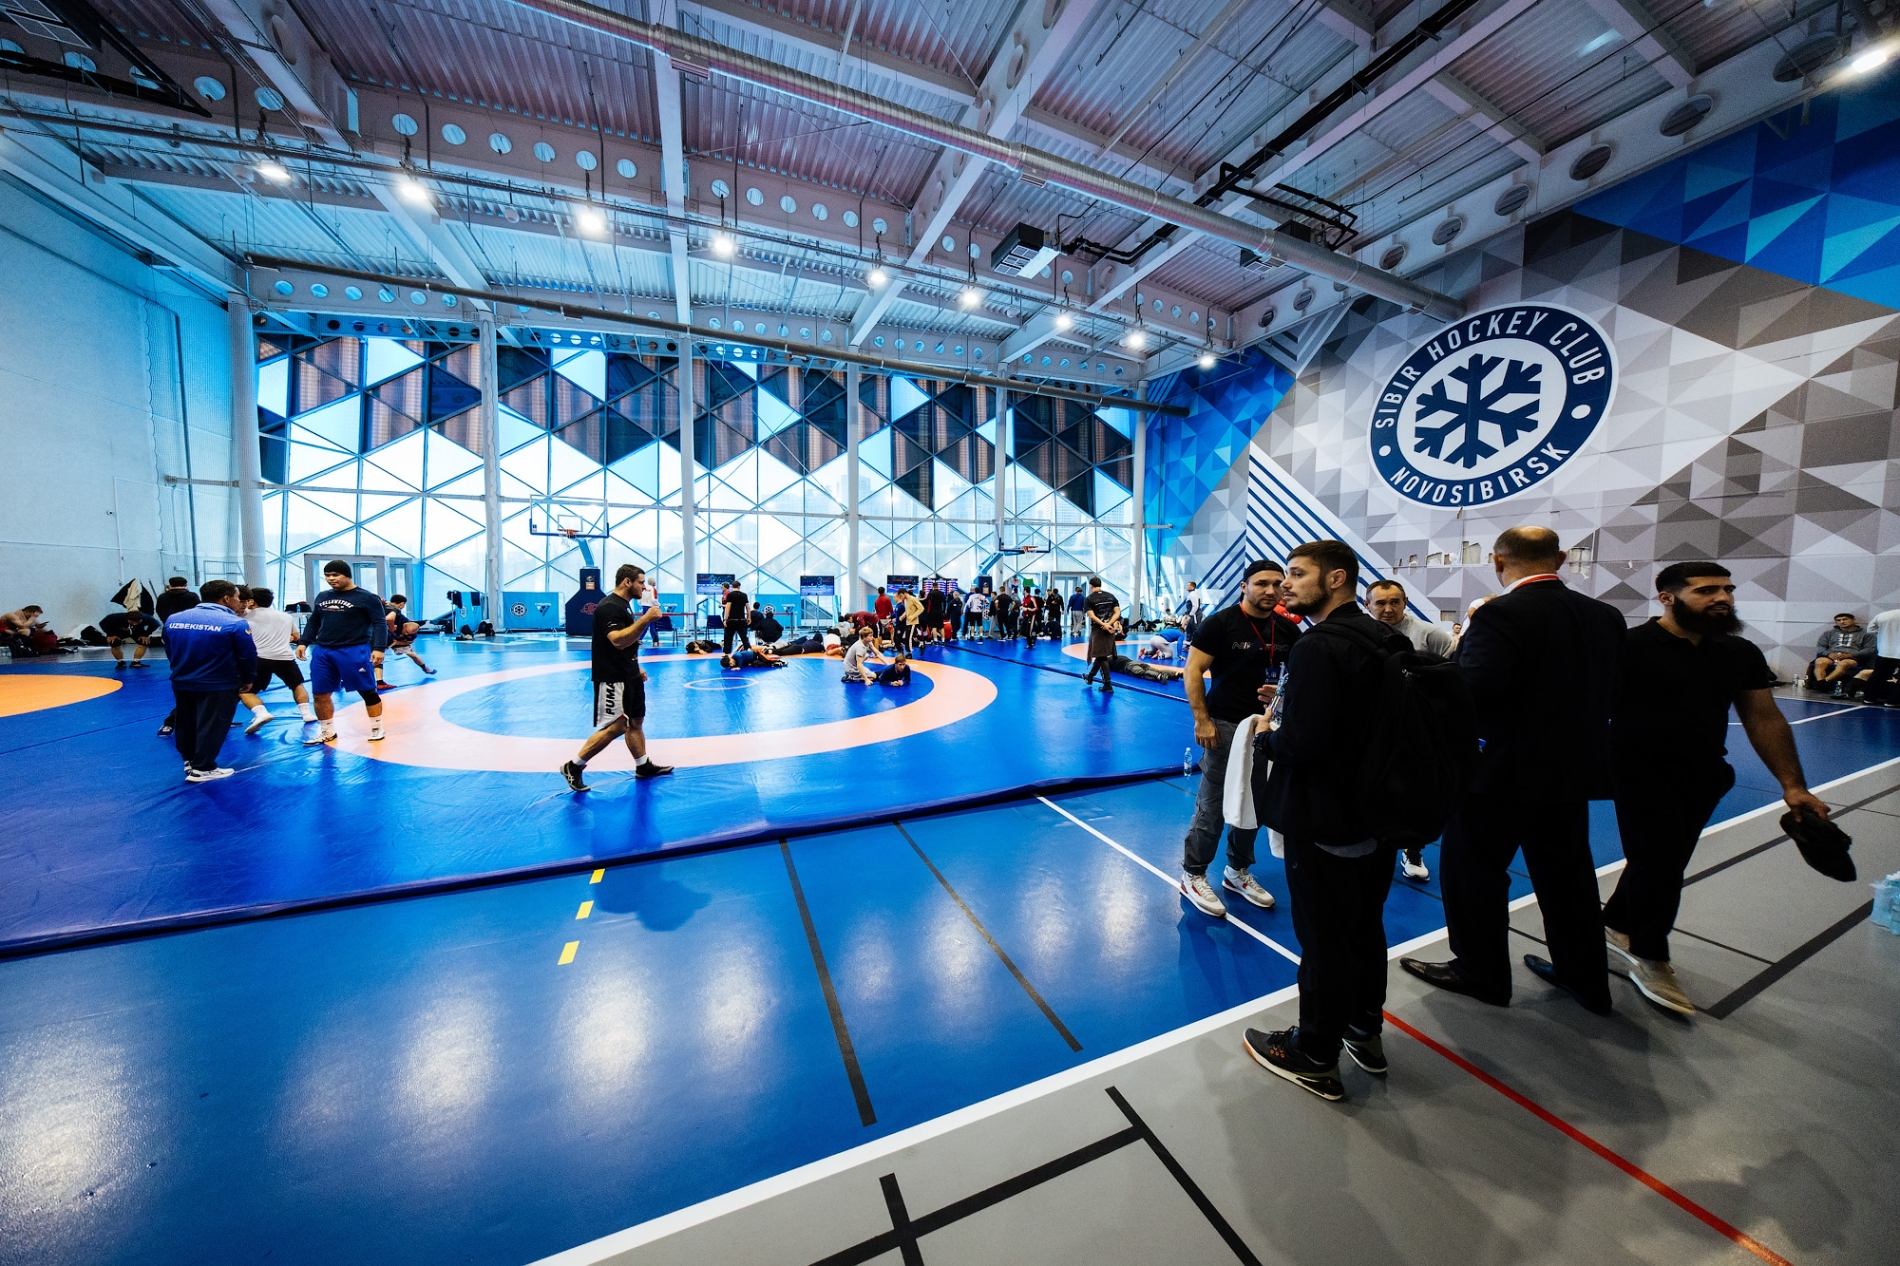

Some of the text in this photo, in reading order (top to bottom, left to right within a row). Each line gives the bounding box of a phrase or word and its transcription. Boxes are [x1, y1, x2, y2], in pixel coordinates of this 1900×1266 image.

[1375, 311, 1606, 429] SIBIR HOCKEY CLUB
[1390, 441, 1571, 504] NOVOSIBIRSK
[169, 622, 222, 632] UZBEKISTAN
[605, 681, 616, 716] PUMA
